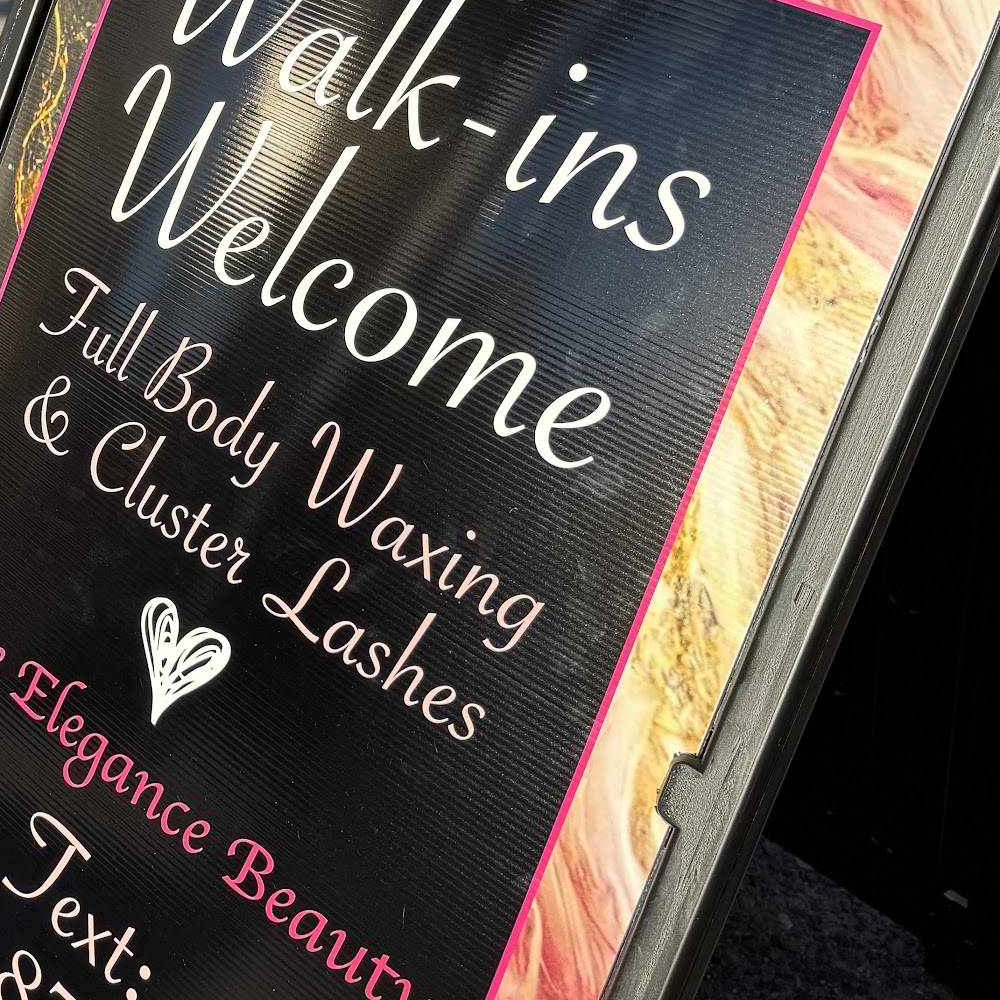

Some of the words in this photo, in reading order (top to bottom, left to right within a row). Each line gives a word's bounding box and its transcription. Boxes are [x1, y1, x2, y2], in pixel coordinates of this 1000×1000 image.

[111, 63, 612, 470] Welcome
[23, 375, 71, 456] &
[90, 421, 251, 585] Cluster
[262, 557, 486, 741] Lashes
[38, 267, 159, 382] Full
[143, 336, 280, 489] Body
[307, 421, 546, 653] Waxing
[1, 811, 151, 1000] Text:
[9, 660, 211, 854] Elegance
